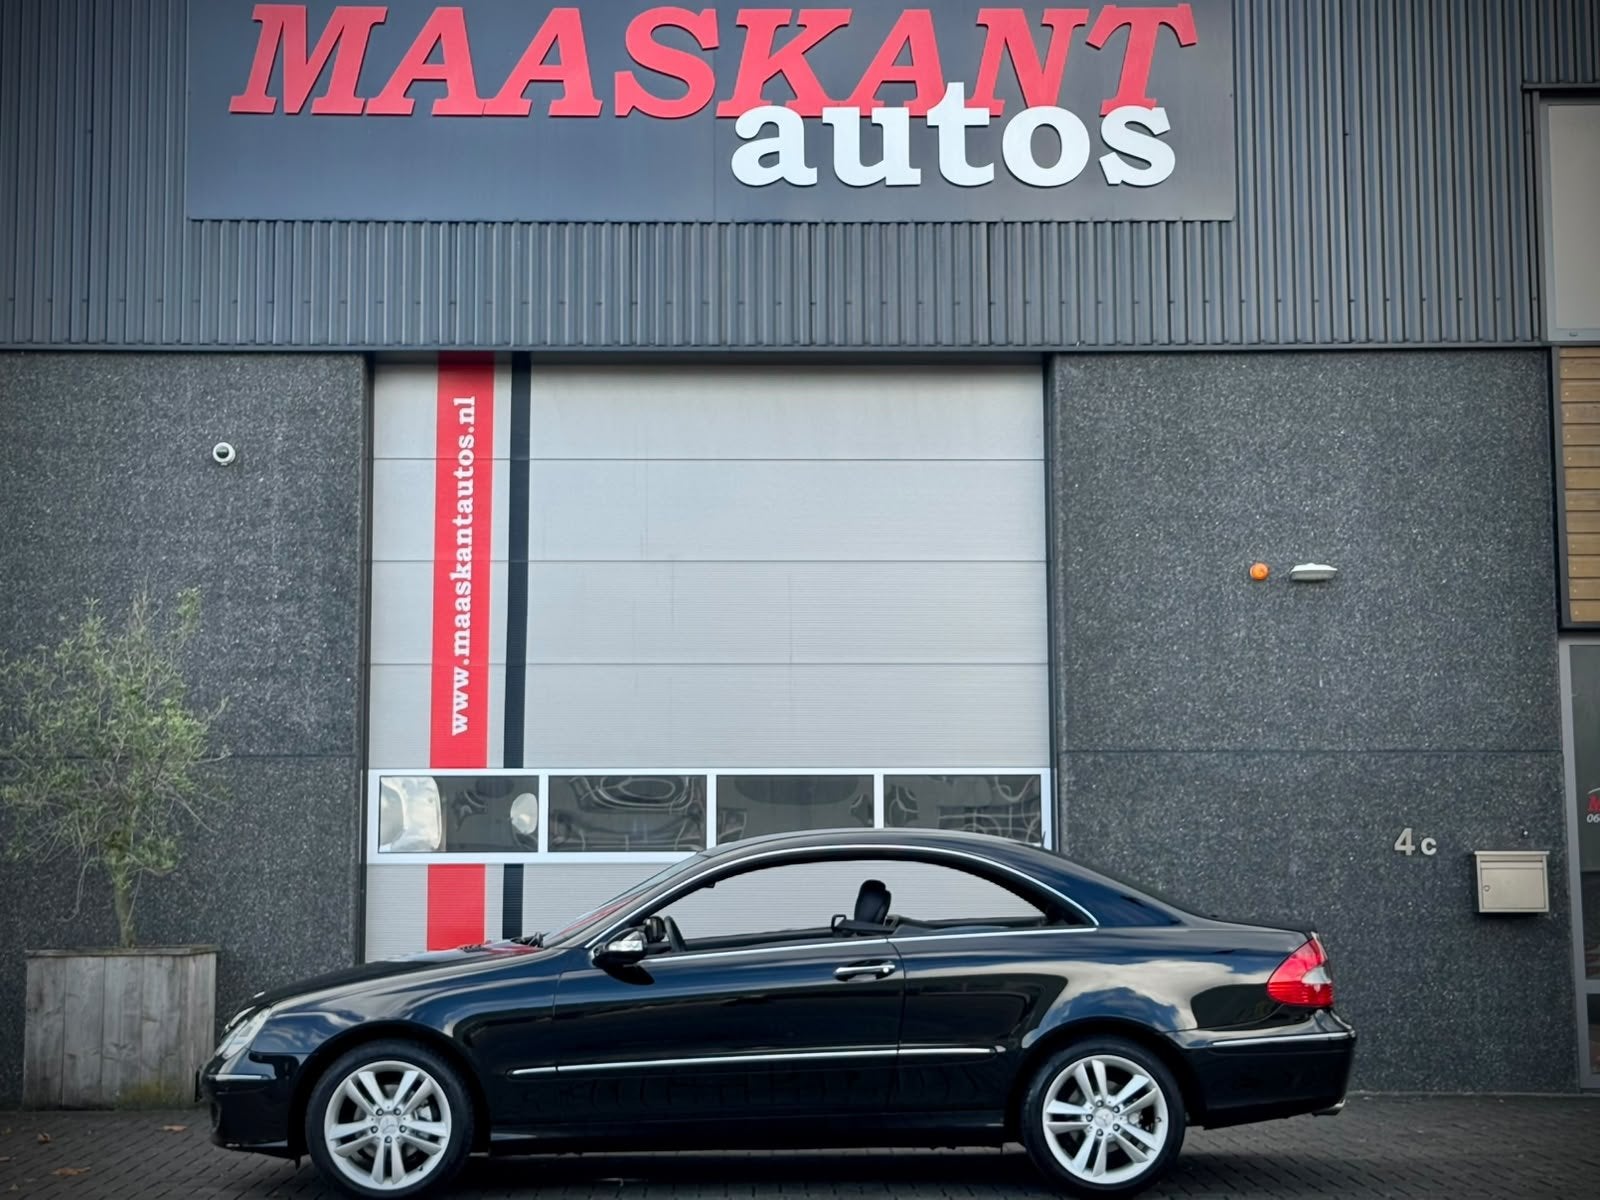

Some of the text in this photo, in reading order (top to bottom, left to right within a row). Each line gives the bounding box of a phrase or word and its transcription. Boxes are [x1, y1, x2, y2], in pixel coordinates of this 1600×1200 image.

[229, 3, 1197, 119] MAASKANT
[731, 82, 1177, 188] autos
[449, 395, 476, 736] www.maaskantautos.nl
